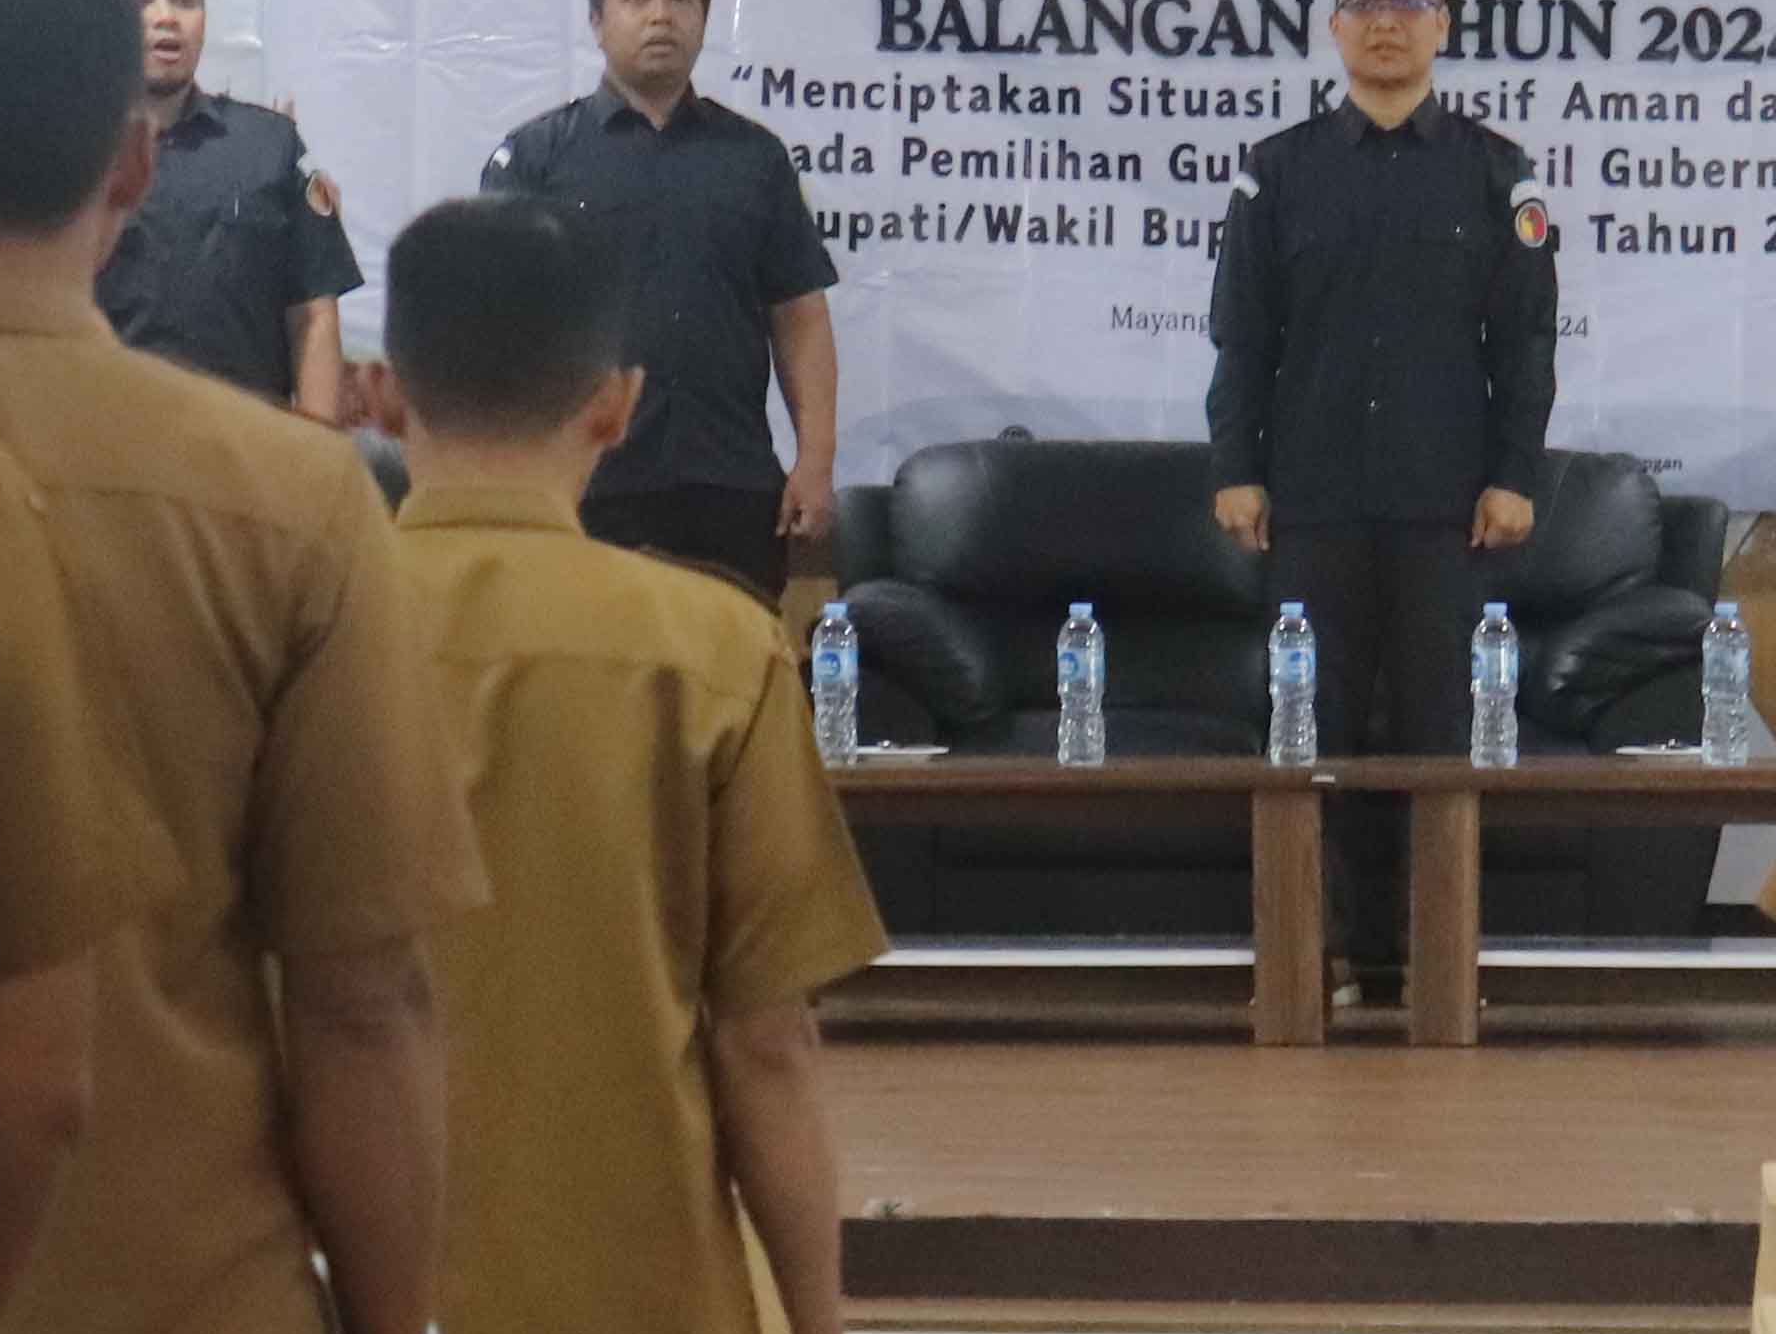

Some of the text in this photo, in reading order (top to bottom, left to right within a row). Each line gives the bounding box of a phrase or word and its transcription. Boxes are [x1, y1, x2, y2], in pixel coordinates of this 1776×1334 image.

[1108, 76, 1282, 119] Situasi
[1562, 80, 1701, 122] Aman
[790, 132, 875, 174] ada
[901, 136, 1142, 182] Pemilihan
[816, 203, 1114, 253] upati/Wakil
[1588, 212, 1736, 255] Tahun
